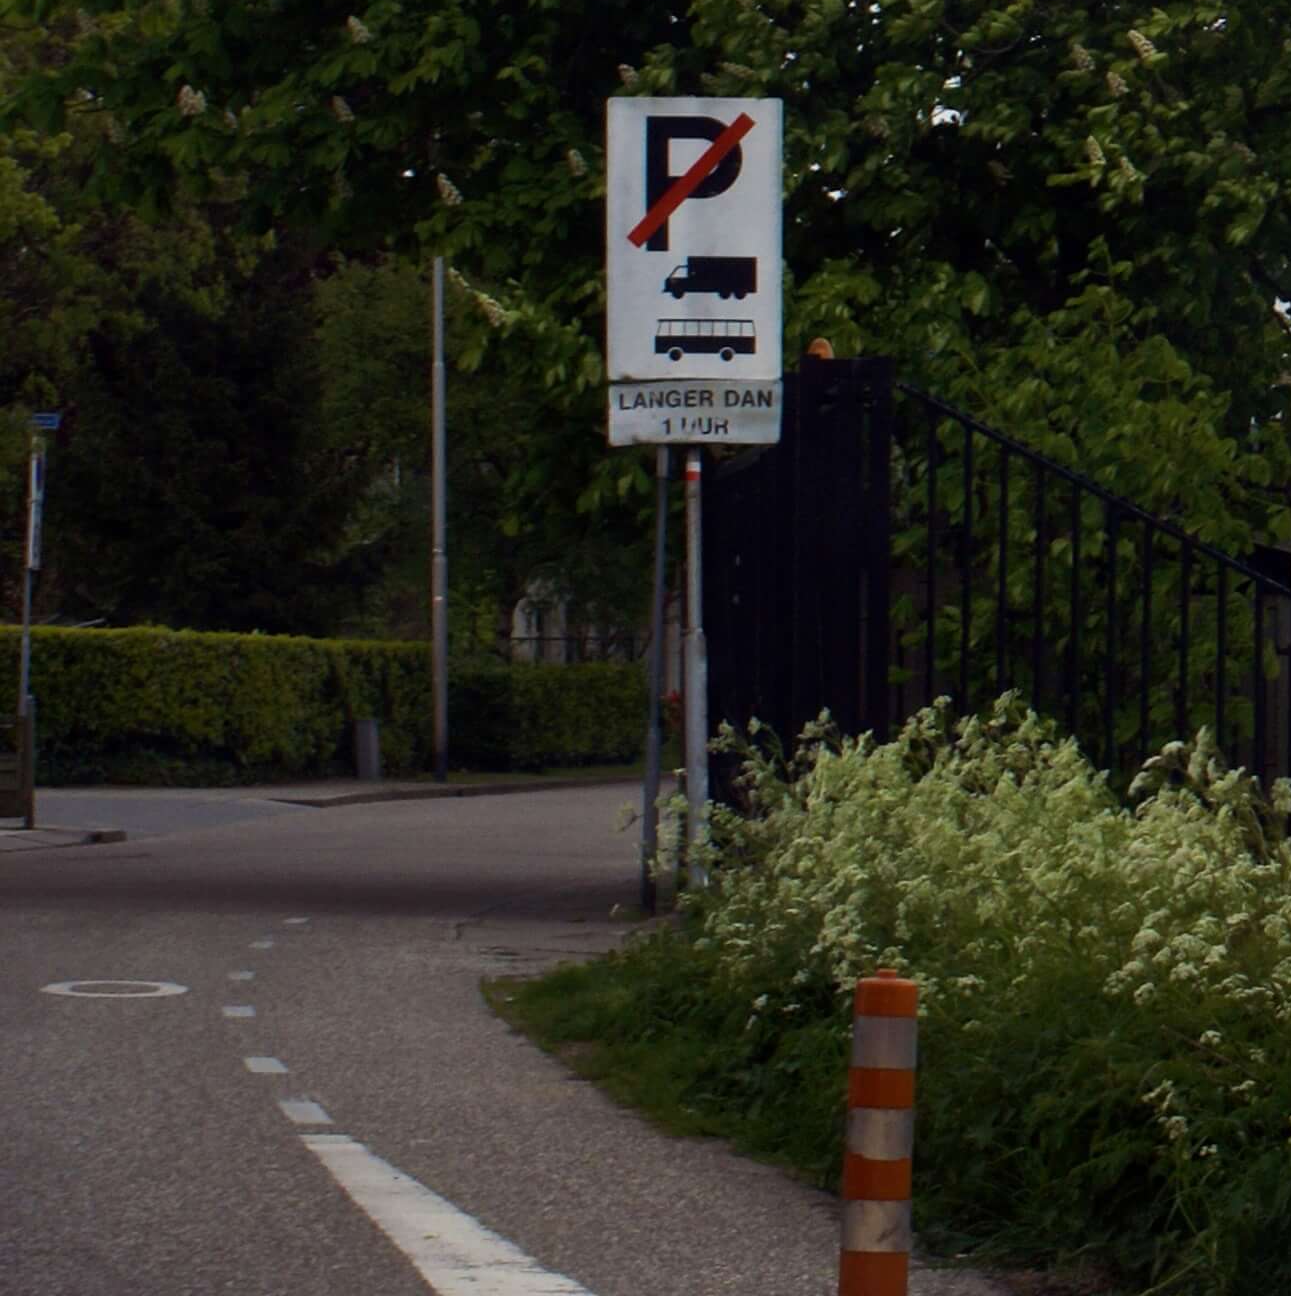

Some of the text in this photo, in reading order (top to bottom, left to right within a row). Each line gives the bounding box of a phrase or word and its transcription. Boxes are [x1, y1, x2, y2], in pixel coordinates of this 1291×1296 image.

[618, 389, 773, 410] LANGER DAN
[662, 417, 672, 435] 1
